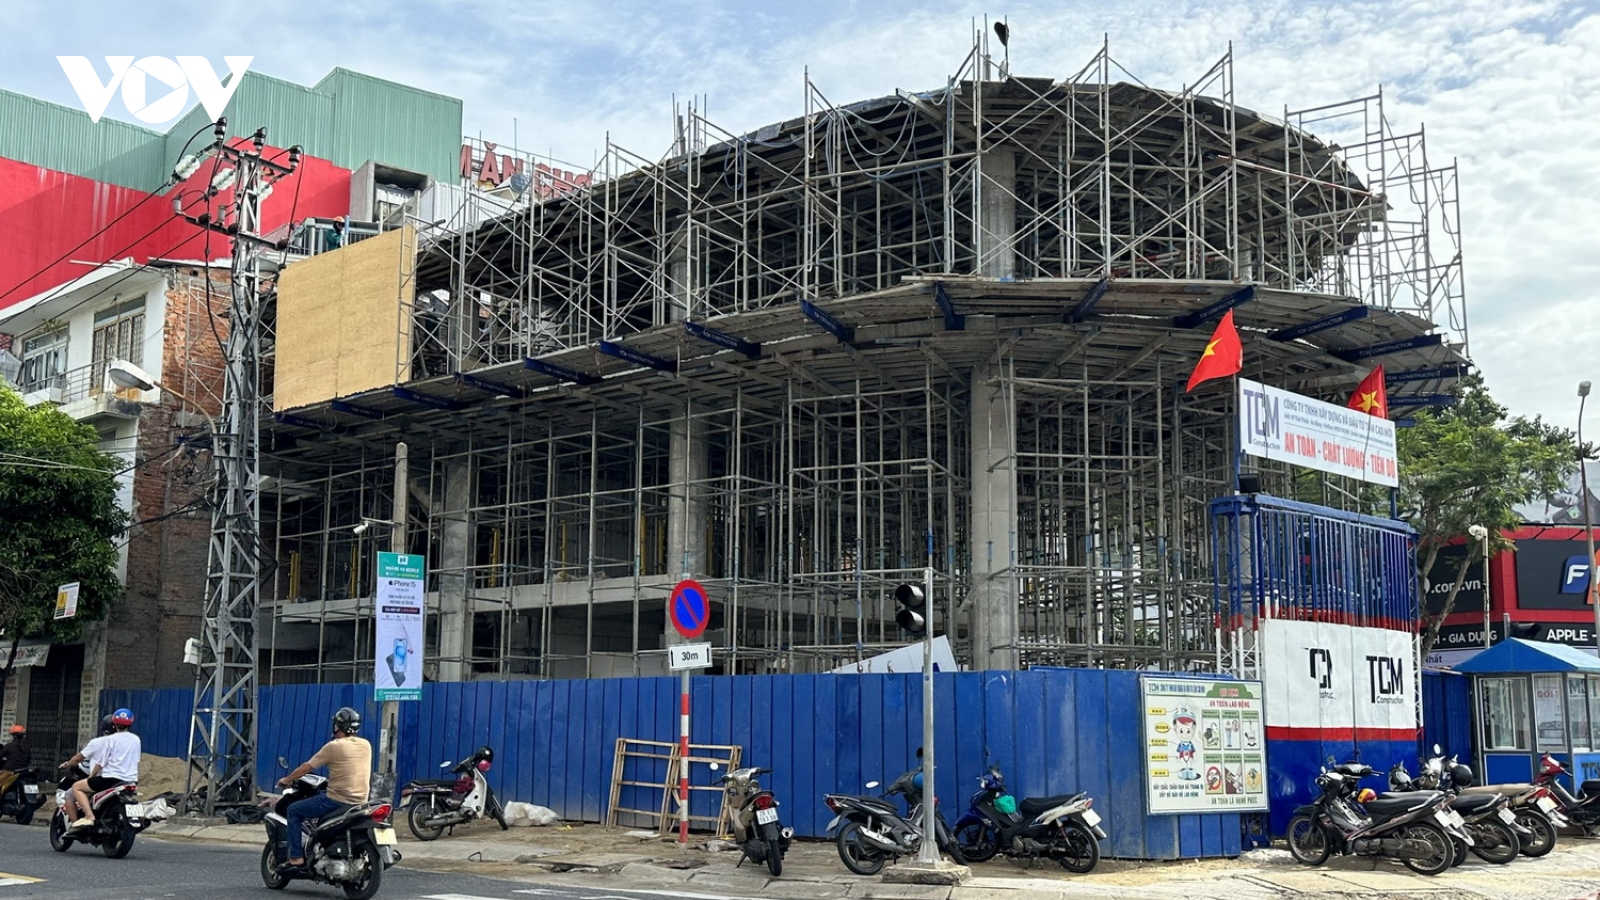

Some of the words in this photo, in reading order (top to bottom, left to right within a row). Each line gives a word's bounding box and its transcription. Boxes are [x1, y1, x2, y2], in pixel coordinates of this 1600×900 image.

[1243, 389, 1280, 444] TCM
[1284, 432, 1295, 454] AN
[1296, 434, 1316, 459] TOÀN
[1323, 437, 1341, 464] CHẤT
[1448, 632, 1466, 643] GIA
[1546, 628, 1589, 641] APPLE
[681, 651, 699, 661] 30m
[1366, 655, 1404, 704] TCM
[1376, 696, 1404, 704] Construction
